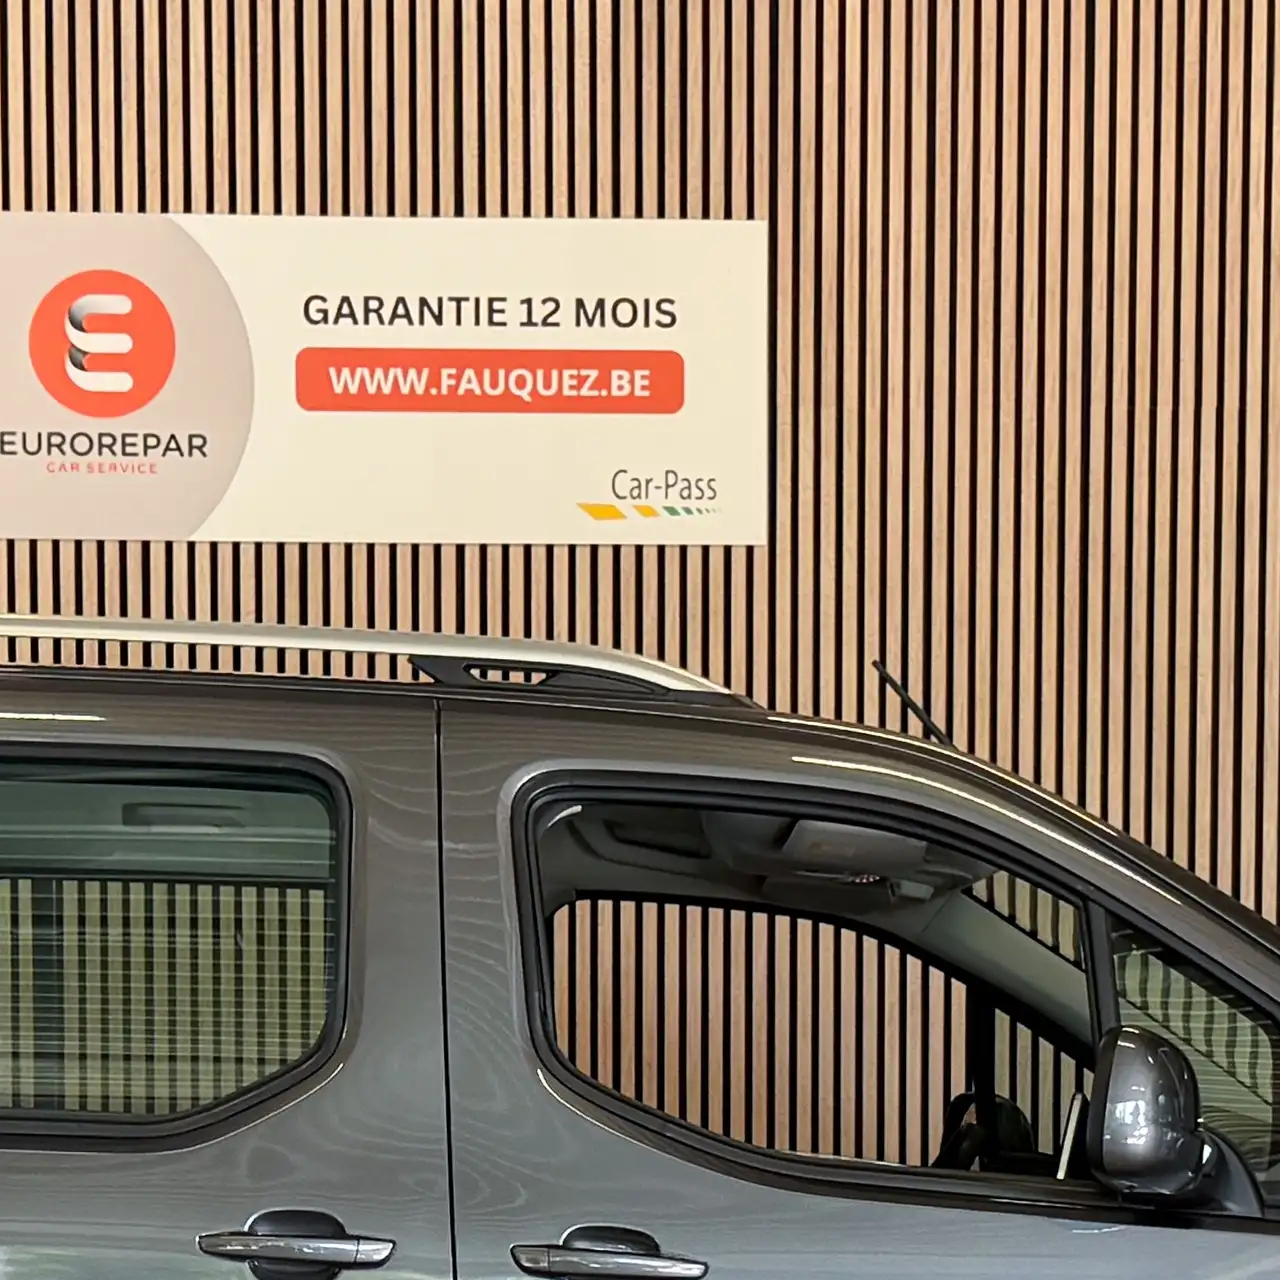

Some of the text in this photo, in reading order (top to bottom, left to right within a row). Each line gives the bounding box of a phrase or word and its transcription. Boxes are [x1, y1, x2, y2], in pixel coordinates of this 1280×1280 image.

[302, 293, 678, 329] GARANTIE 12 MOIS
[328, 365, 652, 403] WWW.FAUQUEZ.BE
[46, 461, 159, 475] CAR SERVICE
[610, 468, 719, 501] Car-Pass
